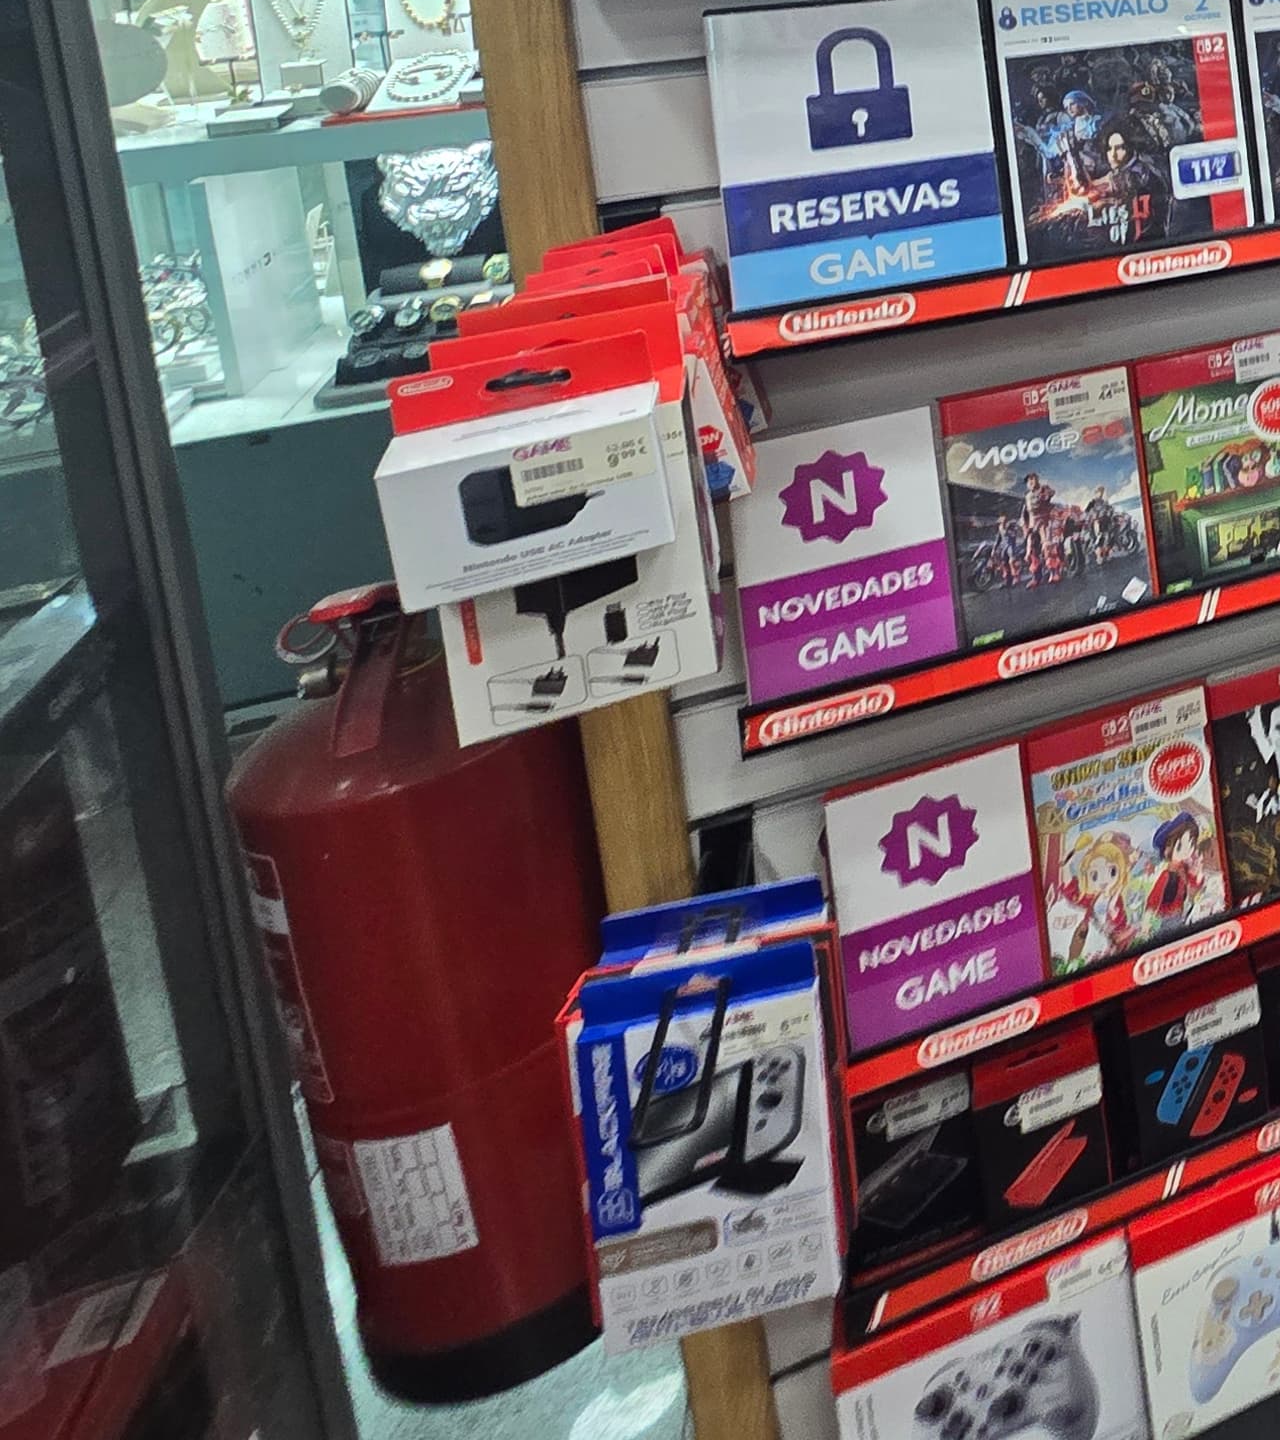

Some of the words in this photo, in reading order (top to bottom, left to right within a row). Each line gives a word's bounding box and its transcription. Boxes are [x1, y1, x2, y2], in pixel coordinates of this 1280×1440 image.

[769, 178, 961, 234] RESERVAS
[809, 237, 935, 286] GAME
[1130, 246, 1222, 275] Nintendo
[792, 299, 905, 332] Nintendo
[808, 469, 858, 524] N
[757, 561, 935, 629] NOVEDADES
[798, 614, 909, 671] GAME
[906, 814, 954, 869] N
[858, 893, 1022, 974] NOVEDADES
[895, 947, 999, 1011] GAME
